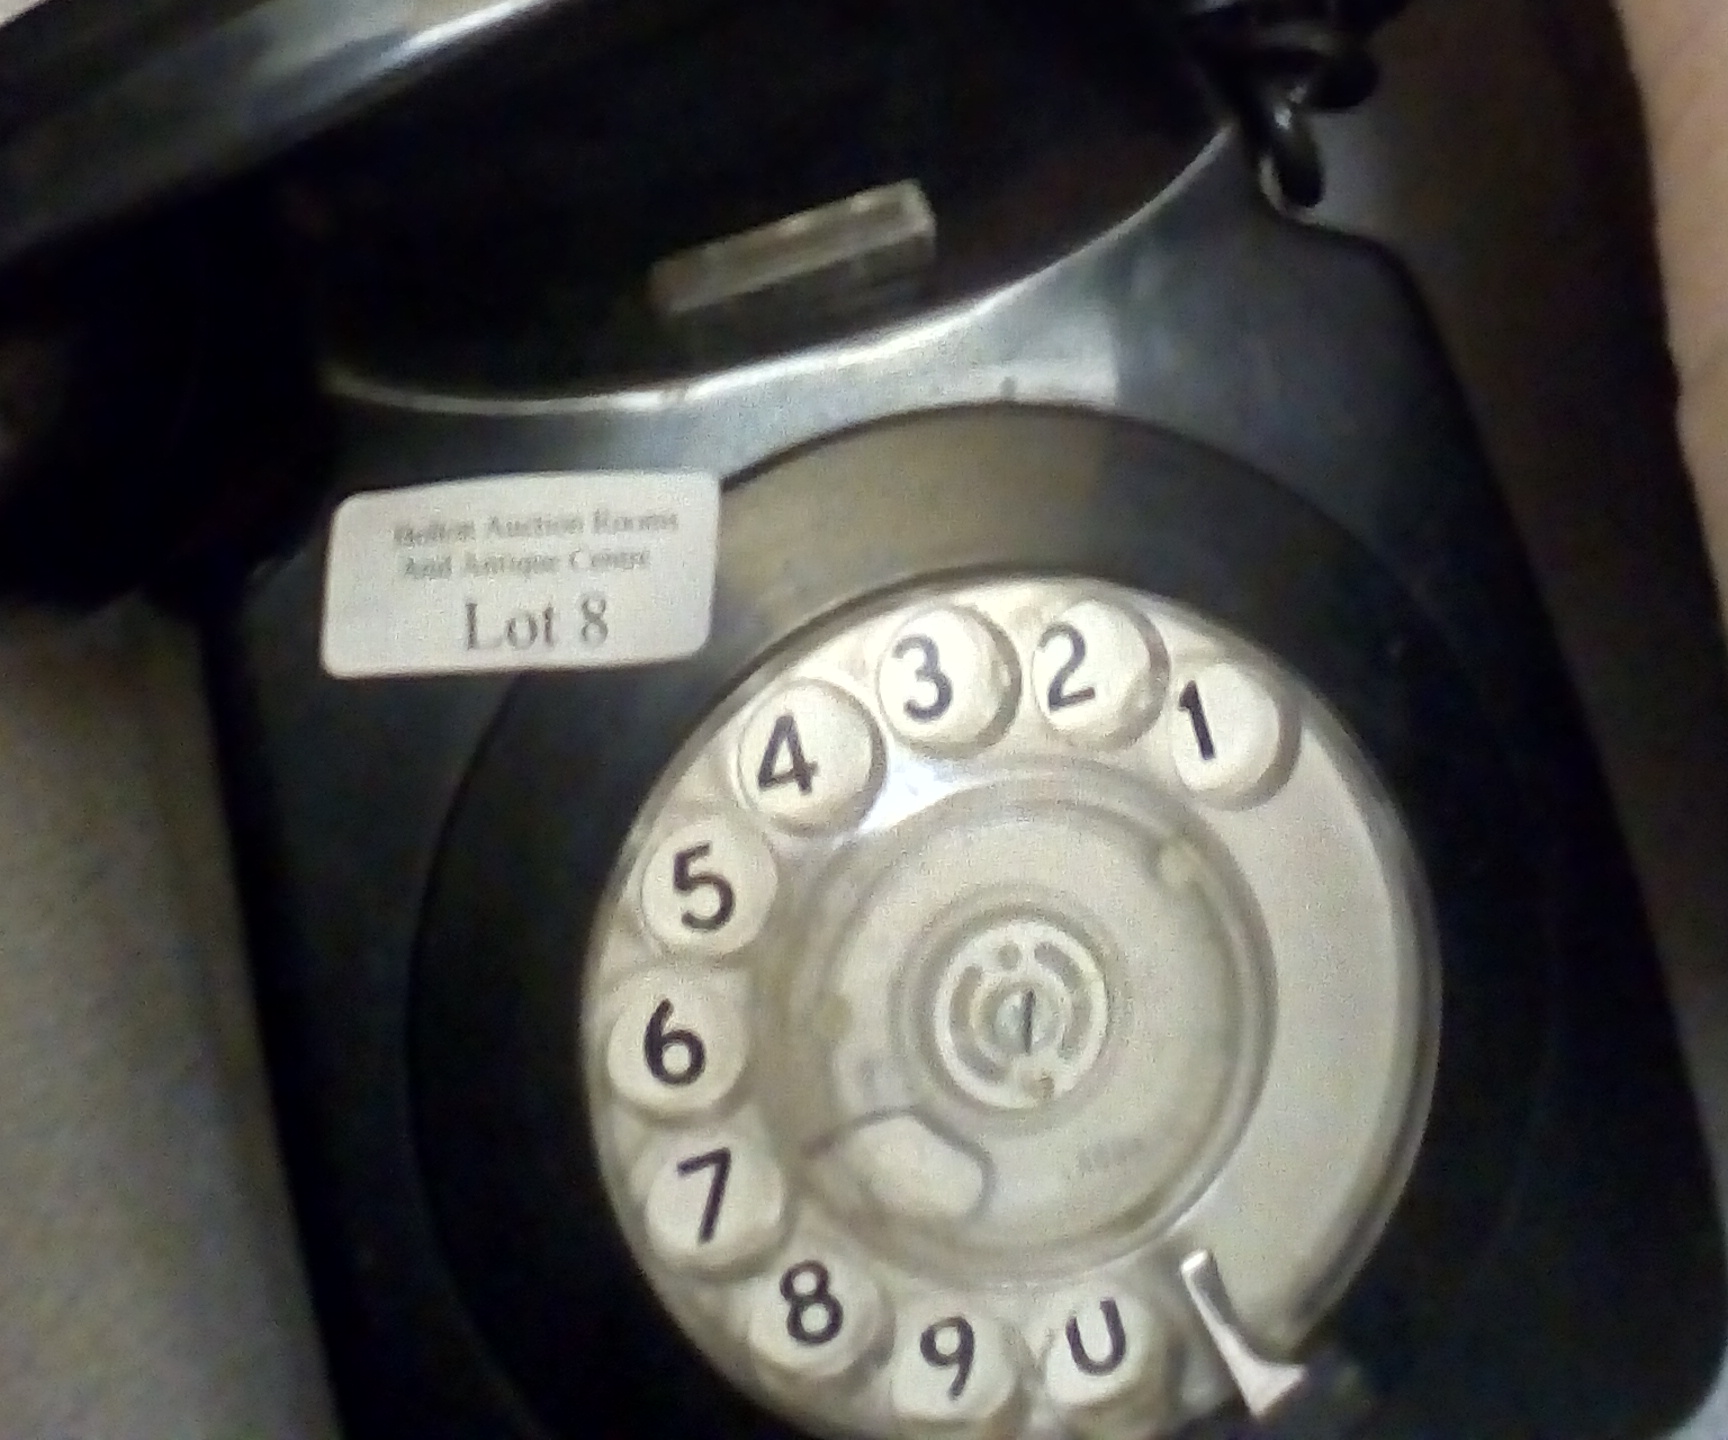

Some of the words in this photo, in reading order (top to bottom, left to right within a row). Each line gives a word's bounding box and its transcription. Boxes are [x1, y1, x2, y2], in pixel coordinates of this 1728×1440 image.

[487, 513, 585, 538] Auction
[464, 600, 557, 651] Lot
[579, 592, 609, 648] 8
[893, 635, 954, 723] 3
[1038, 623, 1095, 711] 2
[757, 714, 818, 796] 4
[1178, 681, 1215, 761] 1
[673, 844, 735, 930] 5
[644, 999, 706, 1086] 6
[677, 1148, 732, 1244] 7
[779, 1260, 844, 1347] 8
[920, 1316, 976, 1400] 9
